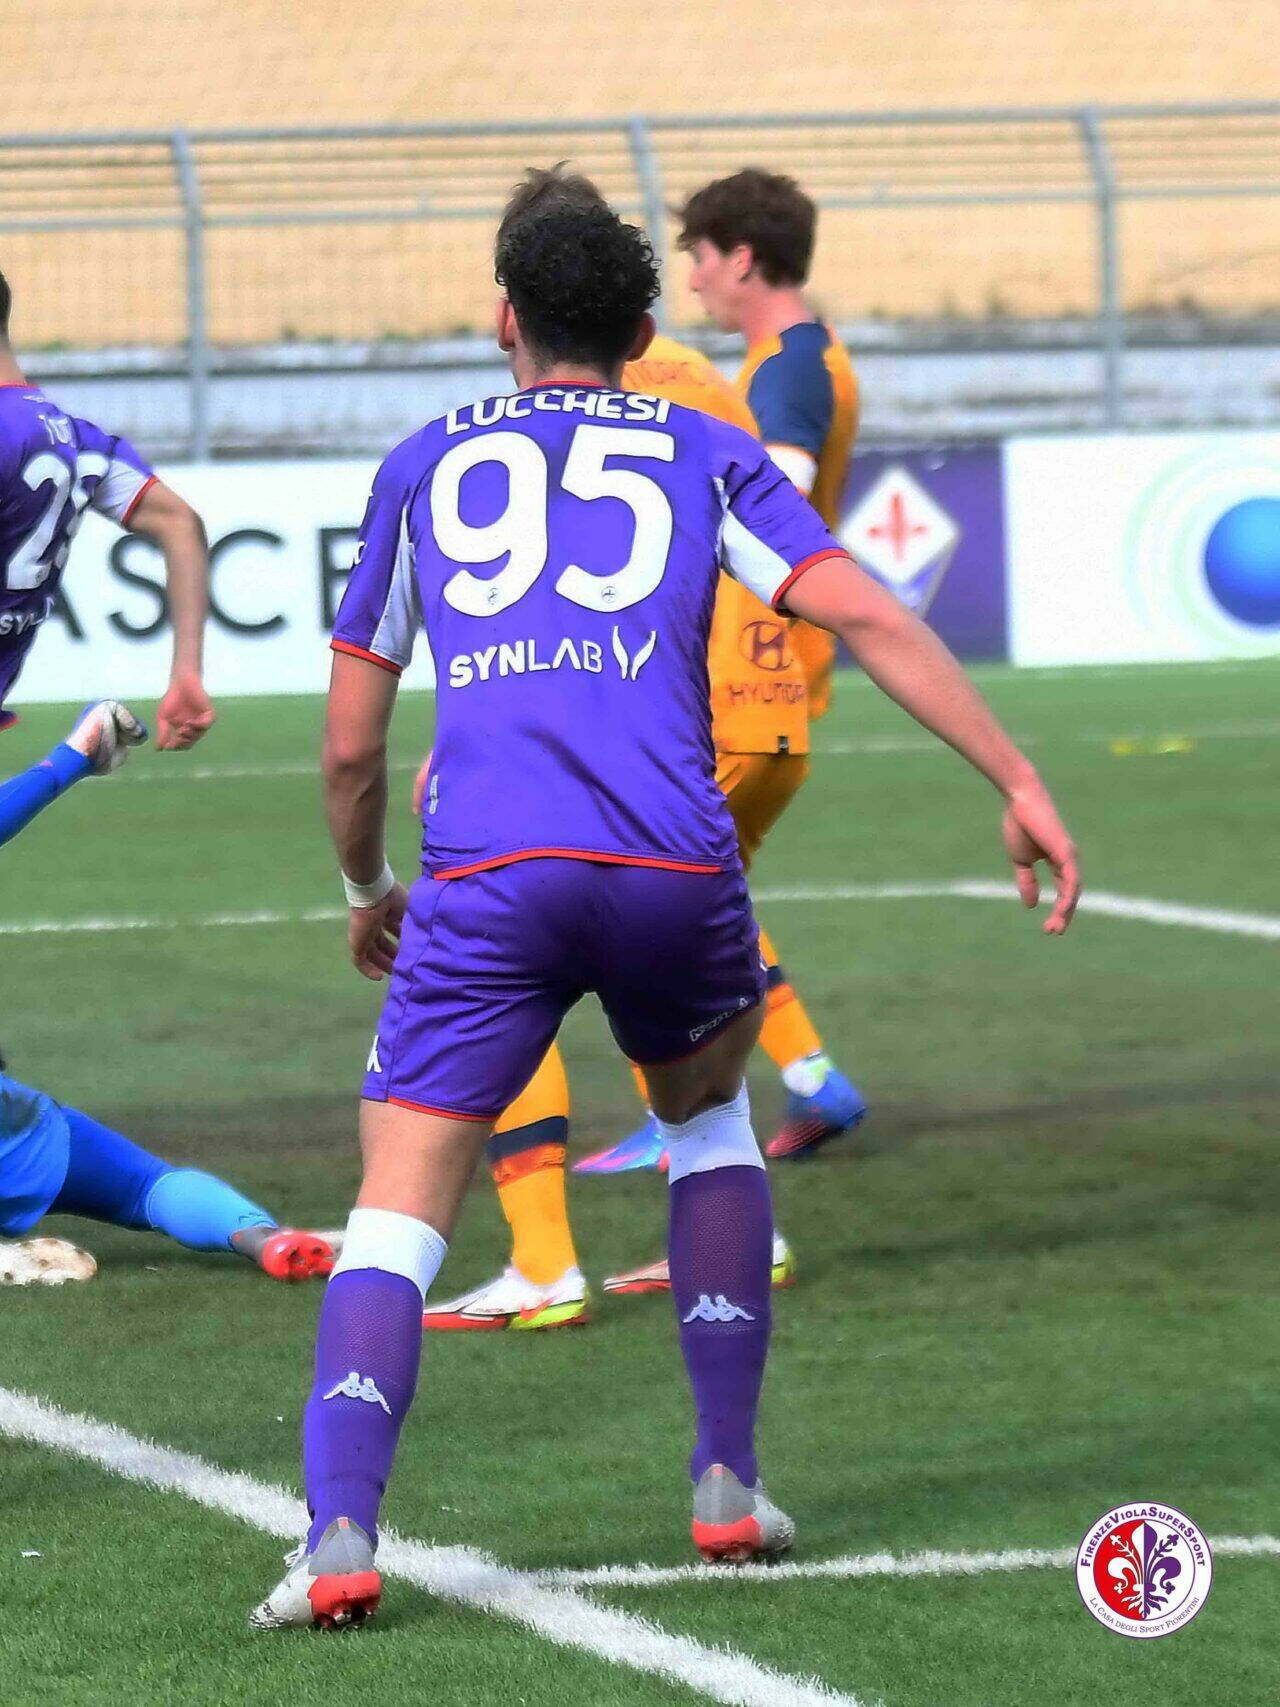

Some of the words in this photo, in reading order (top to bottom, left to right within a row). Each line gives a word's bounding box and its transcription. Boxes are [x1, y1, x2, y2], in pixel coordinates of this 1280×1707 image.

[446, 390, 670, 436] LUCCHESI
[429, 423, 677, 618] 95
[449, 637, 604, 689] SYNLAB
